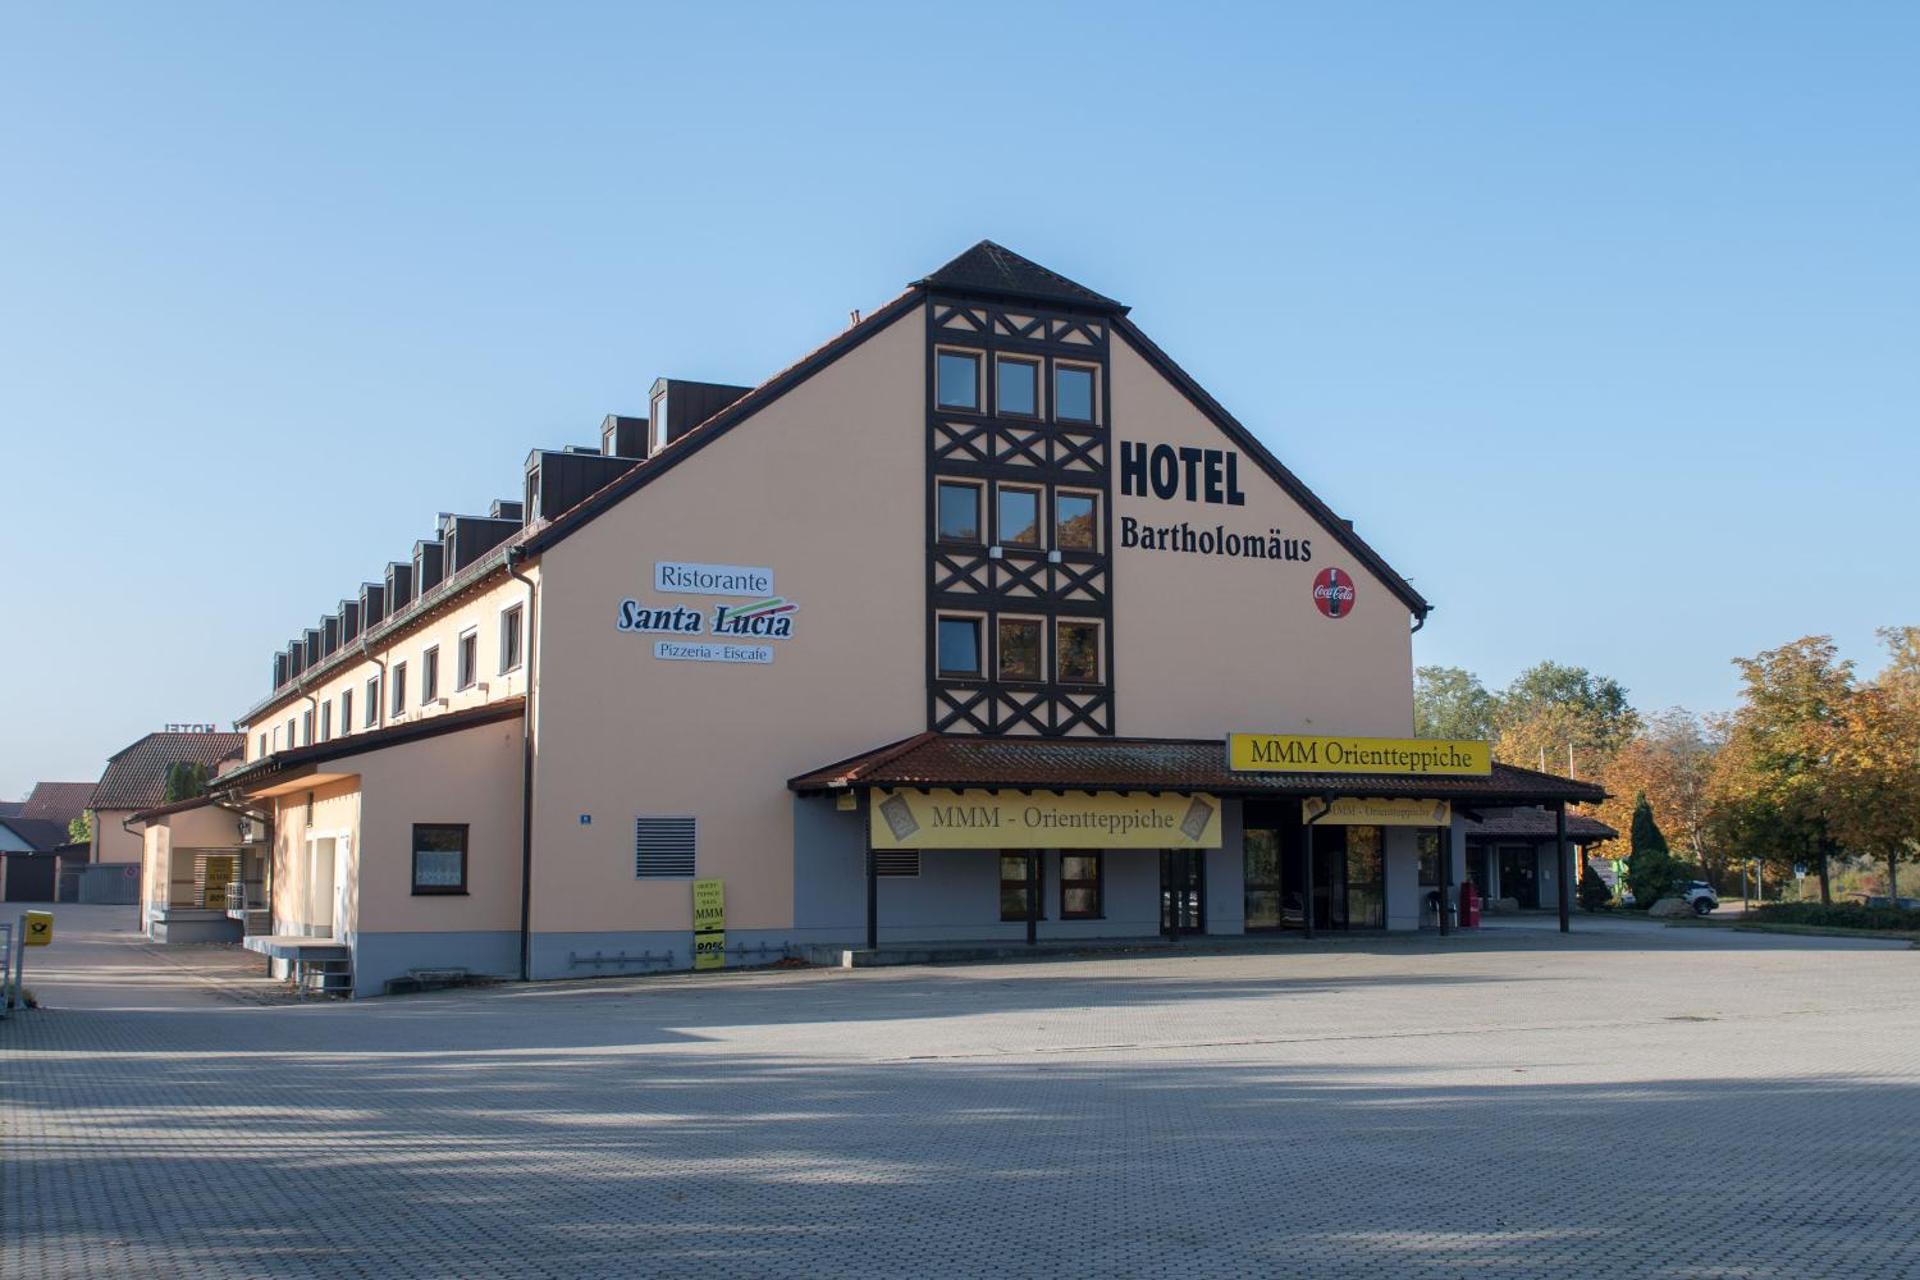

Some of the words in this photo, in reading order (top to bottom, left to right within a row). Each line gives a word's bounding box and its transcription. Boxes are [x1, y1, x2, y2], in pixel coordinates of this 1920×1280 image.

[1119, 440, 1245, 506] HOTEL
[1120, 516, 1312, 562] Bartholomäus
[661, 566, 768, 592] Ristorante
[619, 600, 701, 632] Santa
[713, 606, 792, 636] Lucia
[660, 643, 711, 659] Pizzeria
[1251, 740, 1318, 764] MMM
[1325, 742, 1473, 771] Orientteppiche
[932, 806, 1000, 828] MMM
[1024, 806, 1174, 833] Orientteppiche
[696, 907, 724, 919] MMM
